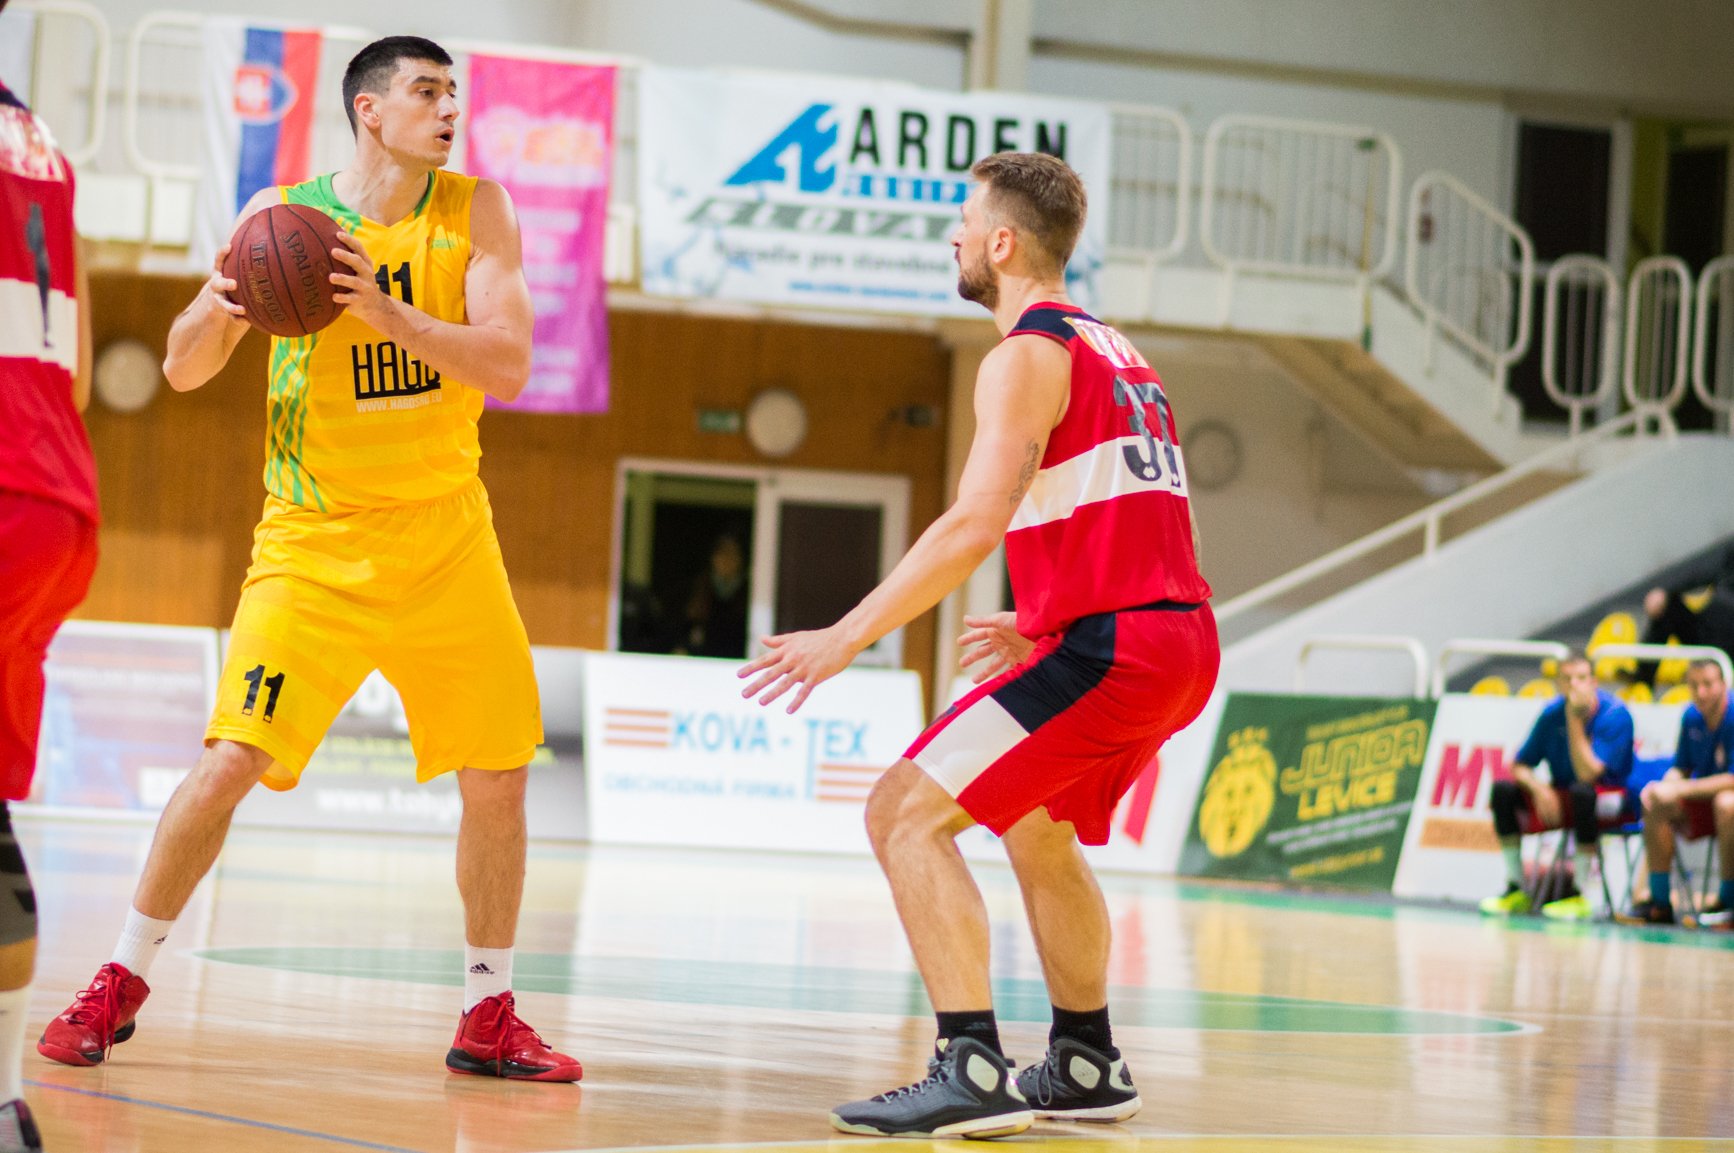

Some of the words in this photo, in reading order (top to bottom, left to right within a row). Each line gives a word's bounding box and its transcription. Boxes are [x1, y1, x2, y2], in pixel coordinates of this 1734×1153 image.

[849, 107, 1067, 172] ARDEN
[281, 229, 325, 317] SPALDING
[374, 261, 414, 306] 11
[241, 663, 286, 724] 11
[672, 711, 771, 752] KOVA
[1280, 718, 1429, 796] JUNIOR
[1297, 770, 1398, 821] LEVICE
